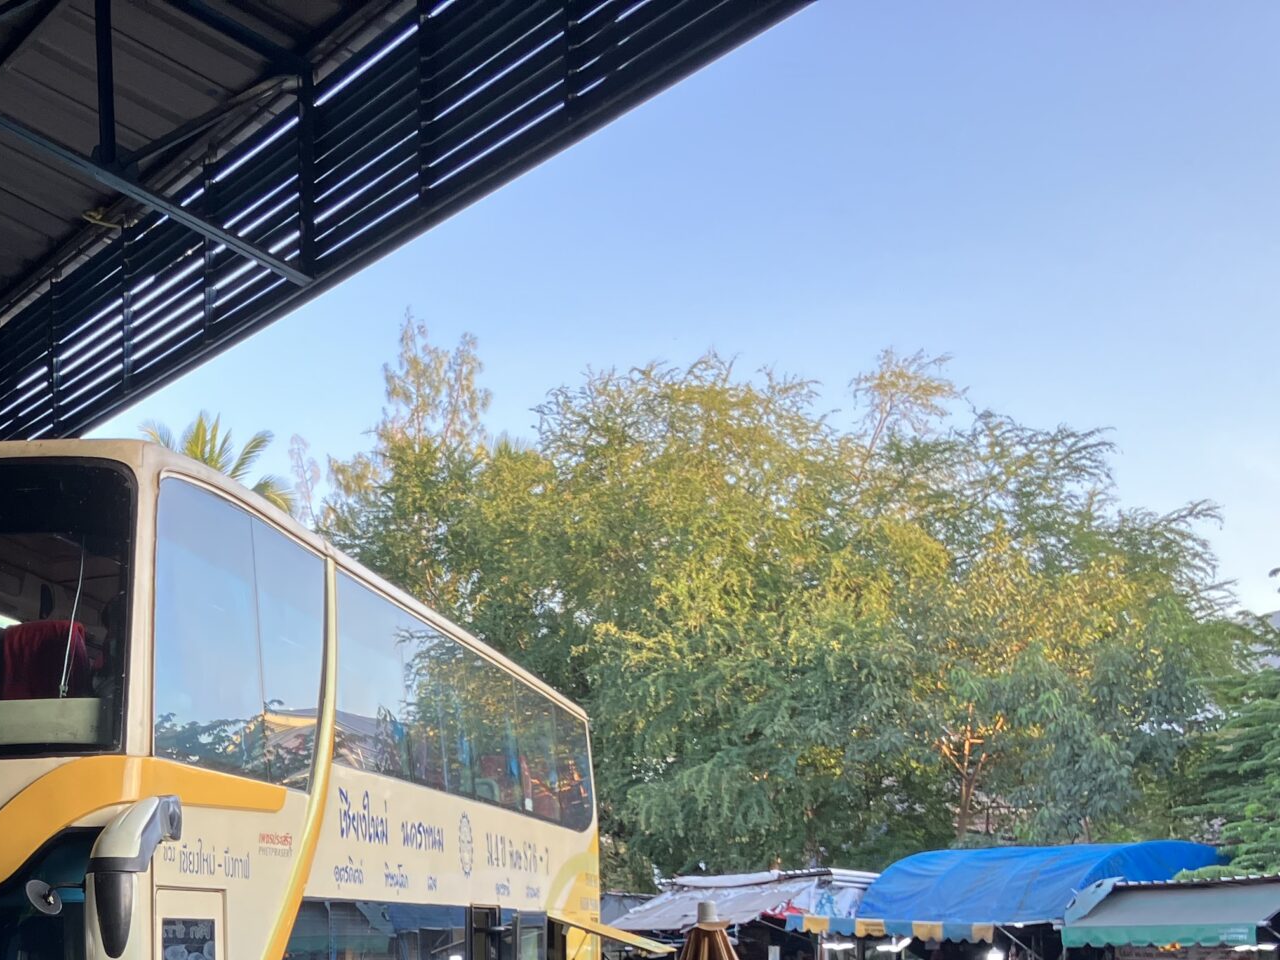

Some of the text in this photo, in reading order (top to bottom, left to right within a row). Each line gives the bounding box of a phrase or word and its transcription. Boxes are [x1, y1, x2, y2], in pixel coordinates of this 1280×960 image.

[339, 786, 389, 846] เชียงใหม่
[179, 837, 216, 876] เชียงใหม่
